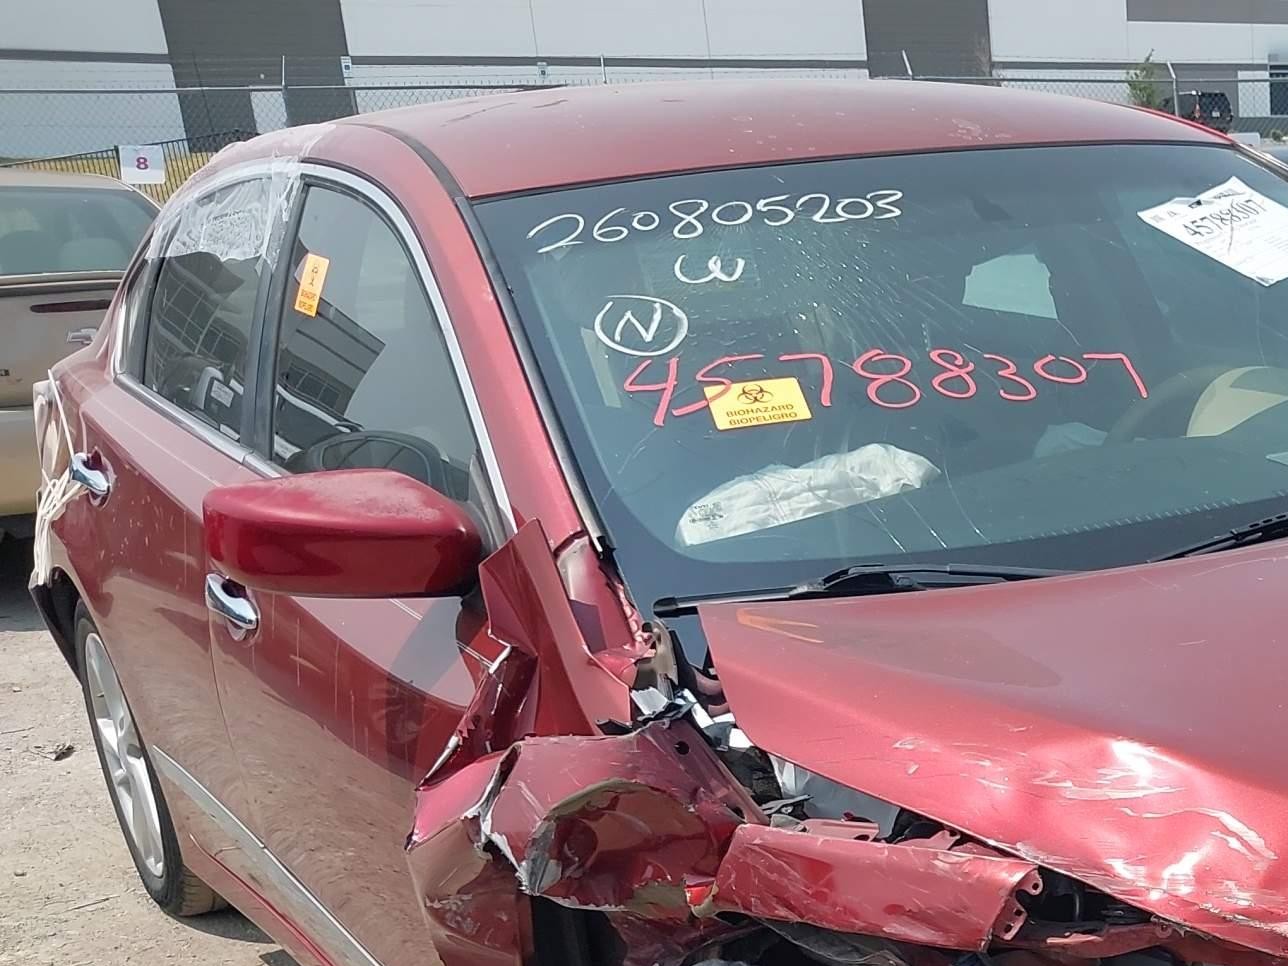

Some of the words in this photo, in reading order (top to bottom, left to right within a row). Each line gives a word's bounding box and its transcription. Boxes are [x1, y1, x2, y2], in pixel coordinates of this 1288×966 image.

[135, 156, 149, 170] 8
[526, 190, 903, 253] 260805203
[623, 348, 1149, 427] 45788307
[726, 403, 794, 418] BIOHAZARD
[729, 411, 797, 426] BIOPELIGRO
